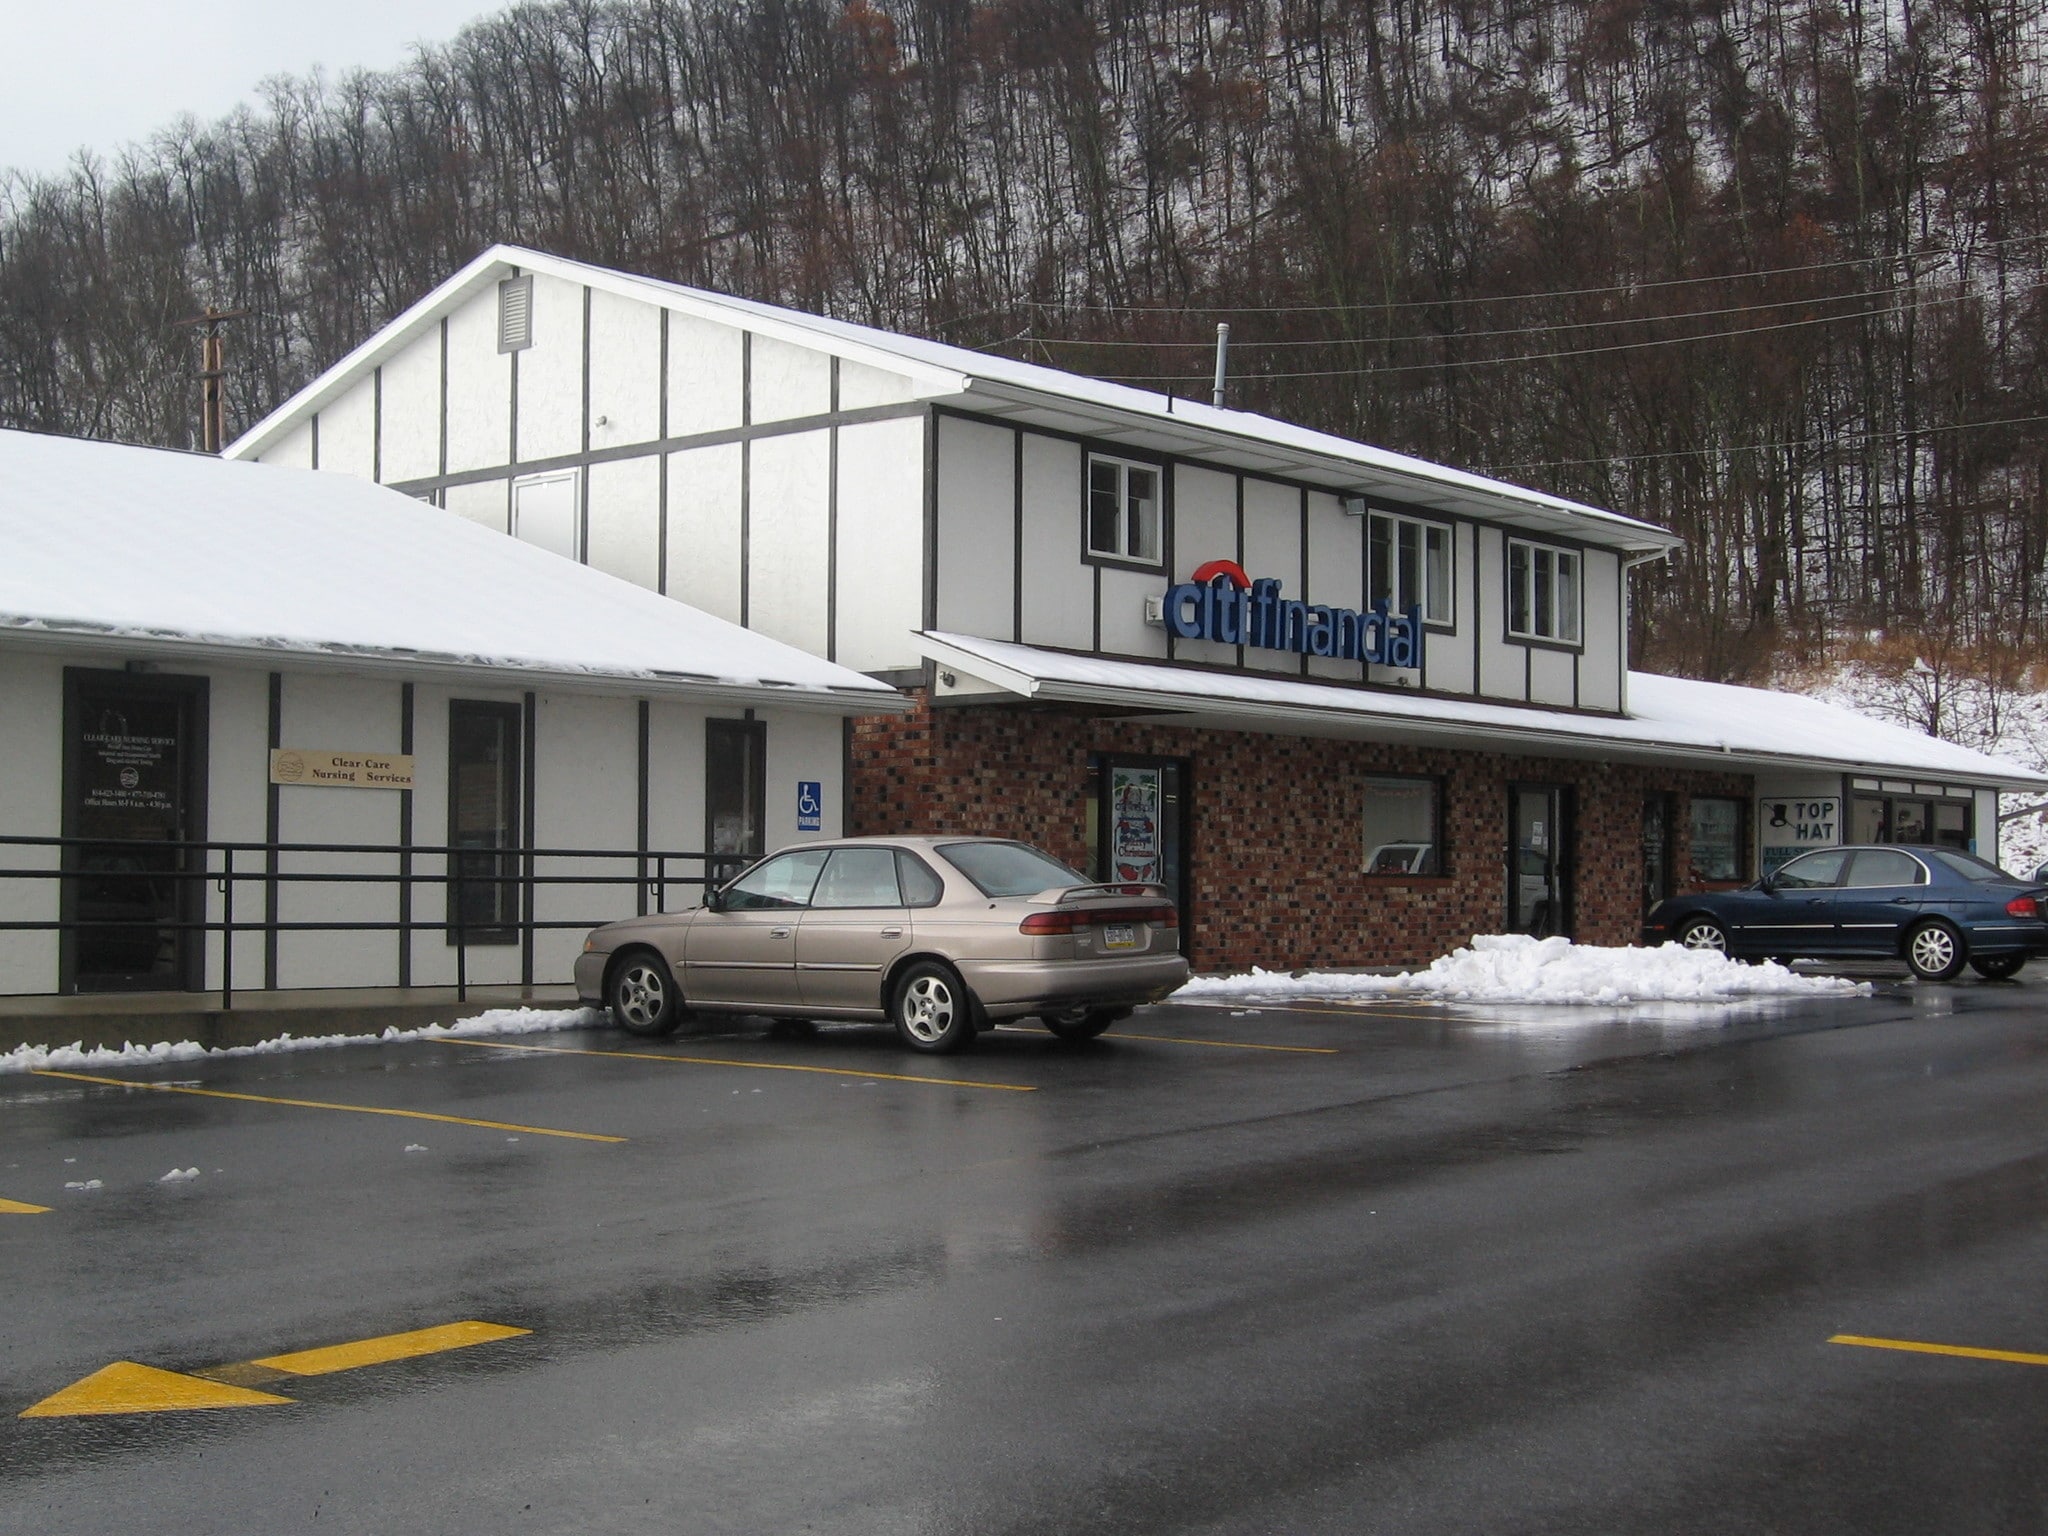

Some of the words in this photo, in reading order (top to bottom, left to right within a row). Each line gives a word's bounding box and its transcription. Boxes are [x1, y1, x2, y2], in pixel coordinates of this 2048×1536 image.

[1164, 573, 1422, 669] citifinancial
[312, 769, 356, 781] Nursing
[366, 772, 412, 783] Services
[1795, 803, 1834, 818] TOP
[1796, 823, 1834, 840] HAT
[1765, 847, 1791, 856] FULL
